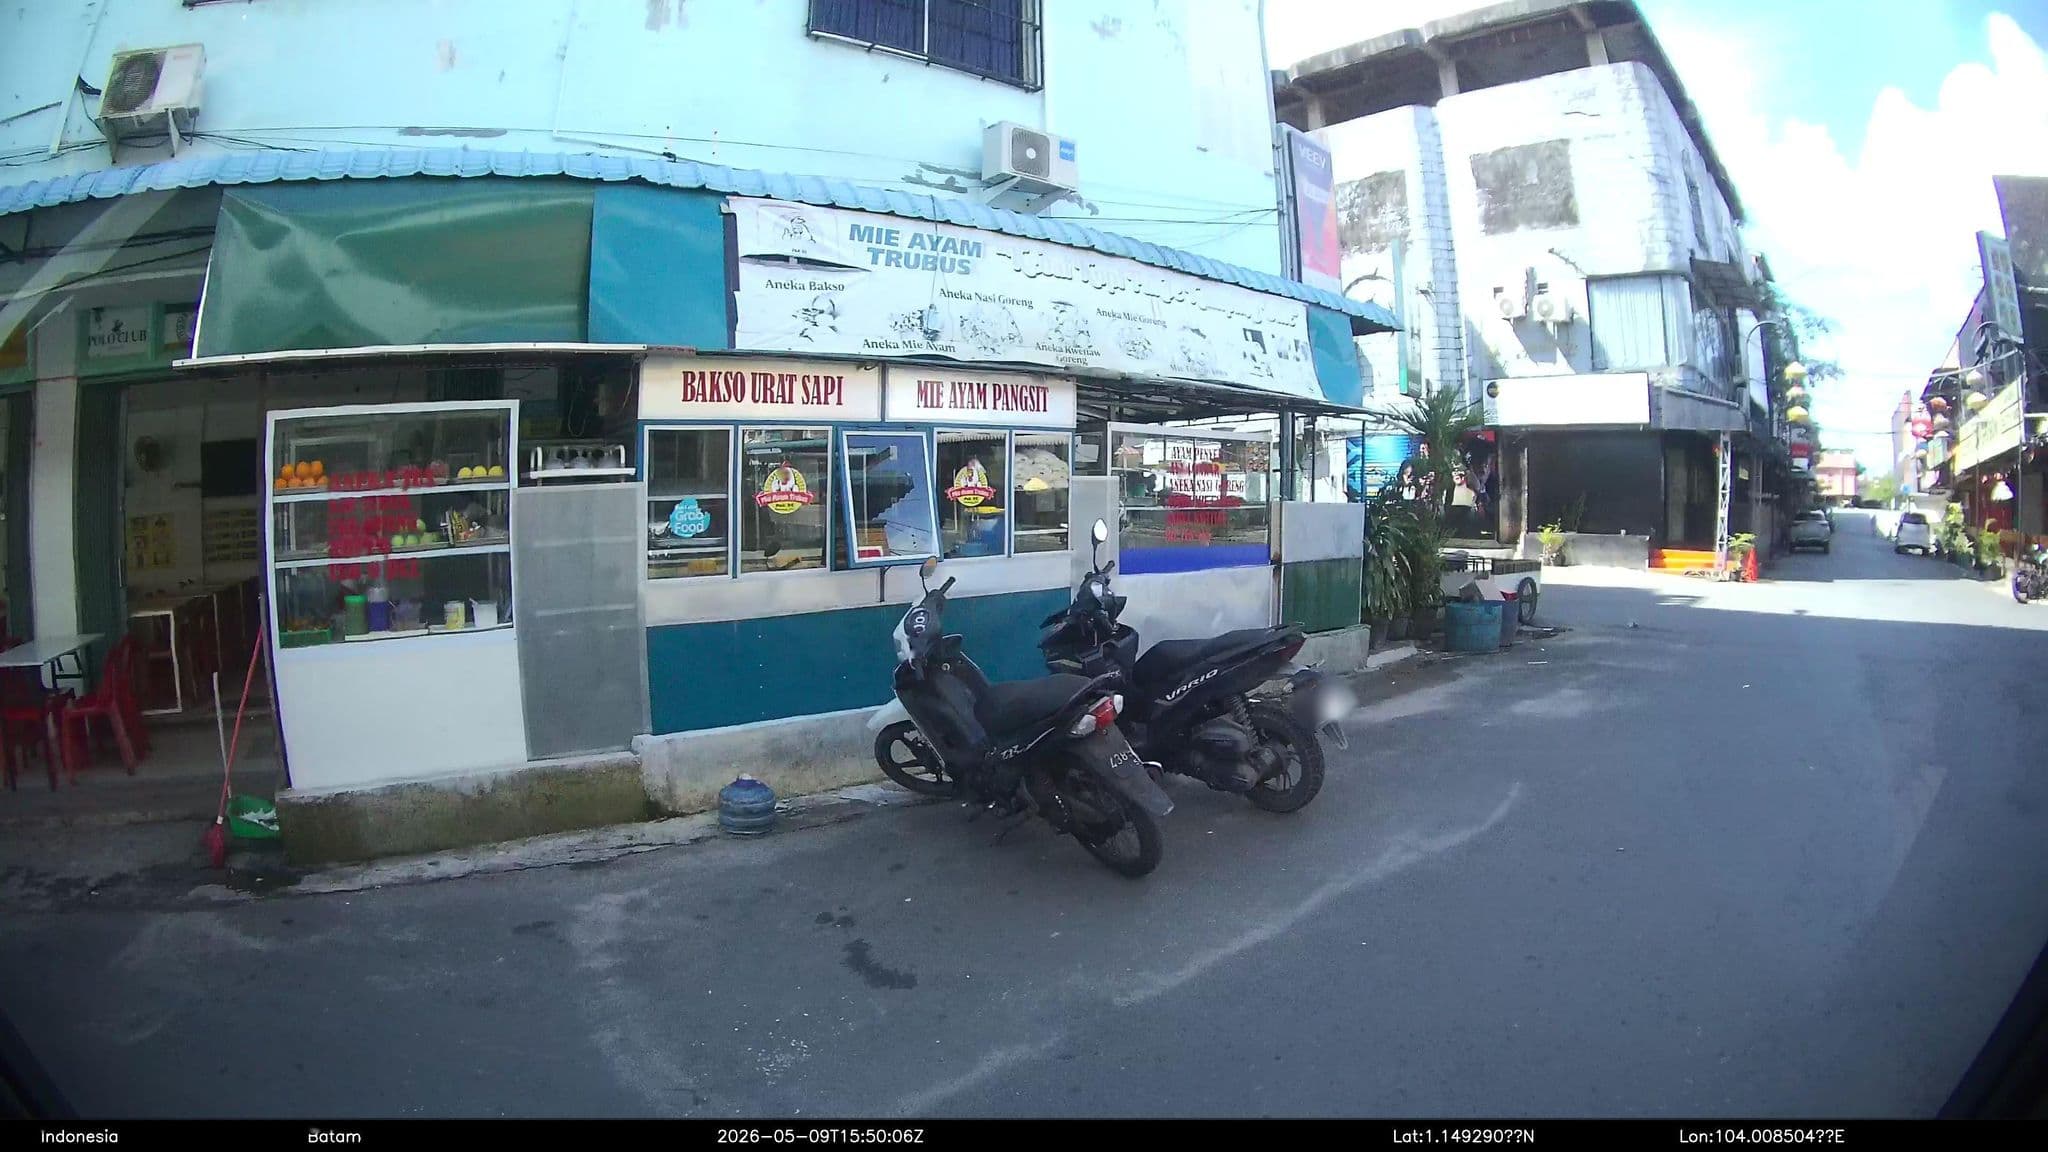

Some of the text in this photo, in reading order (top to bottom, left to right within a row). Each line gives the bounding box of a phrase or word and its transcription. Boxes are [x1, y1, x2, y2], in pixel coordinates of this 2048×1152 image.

[849, 223, 982, 258] MIE AYAM
[867, 247, 971, 275] TRUBUS
[765, 279, 845, 292] Aneka Bakso
[939, 287, 1034, 309] Aneka Nasi Goreng
[1096, 307, 1168, 328] Aneka Mie Goreng
[863, 338, 899, 350] Aneka
[902, 339, 923, 350] Mie
[1036, 342, 1064, 353] Aneka
[682, 371, 844, 406] BAKSO URAT SAPI
[917, 380, 1050, 413] MIE AYAM PANGSIT
[675, 509, 704, 521] Grab
[675, 521, 704, 533] Food
[1165, 668, 1219, 701] VARIO
